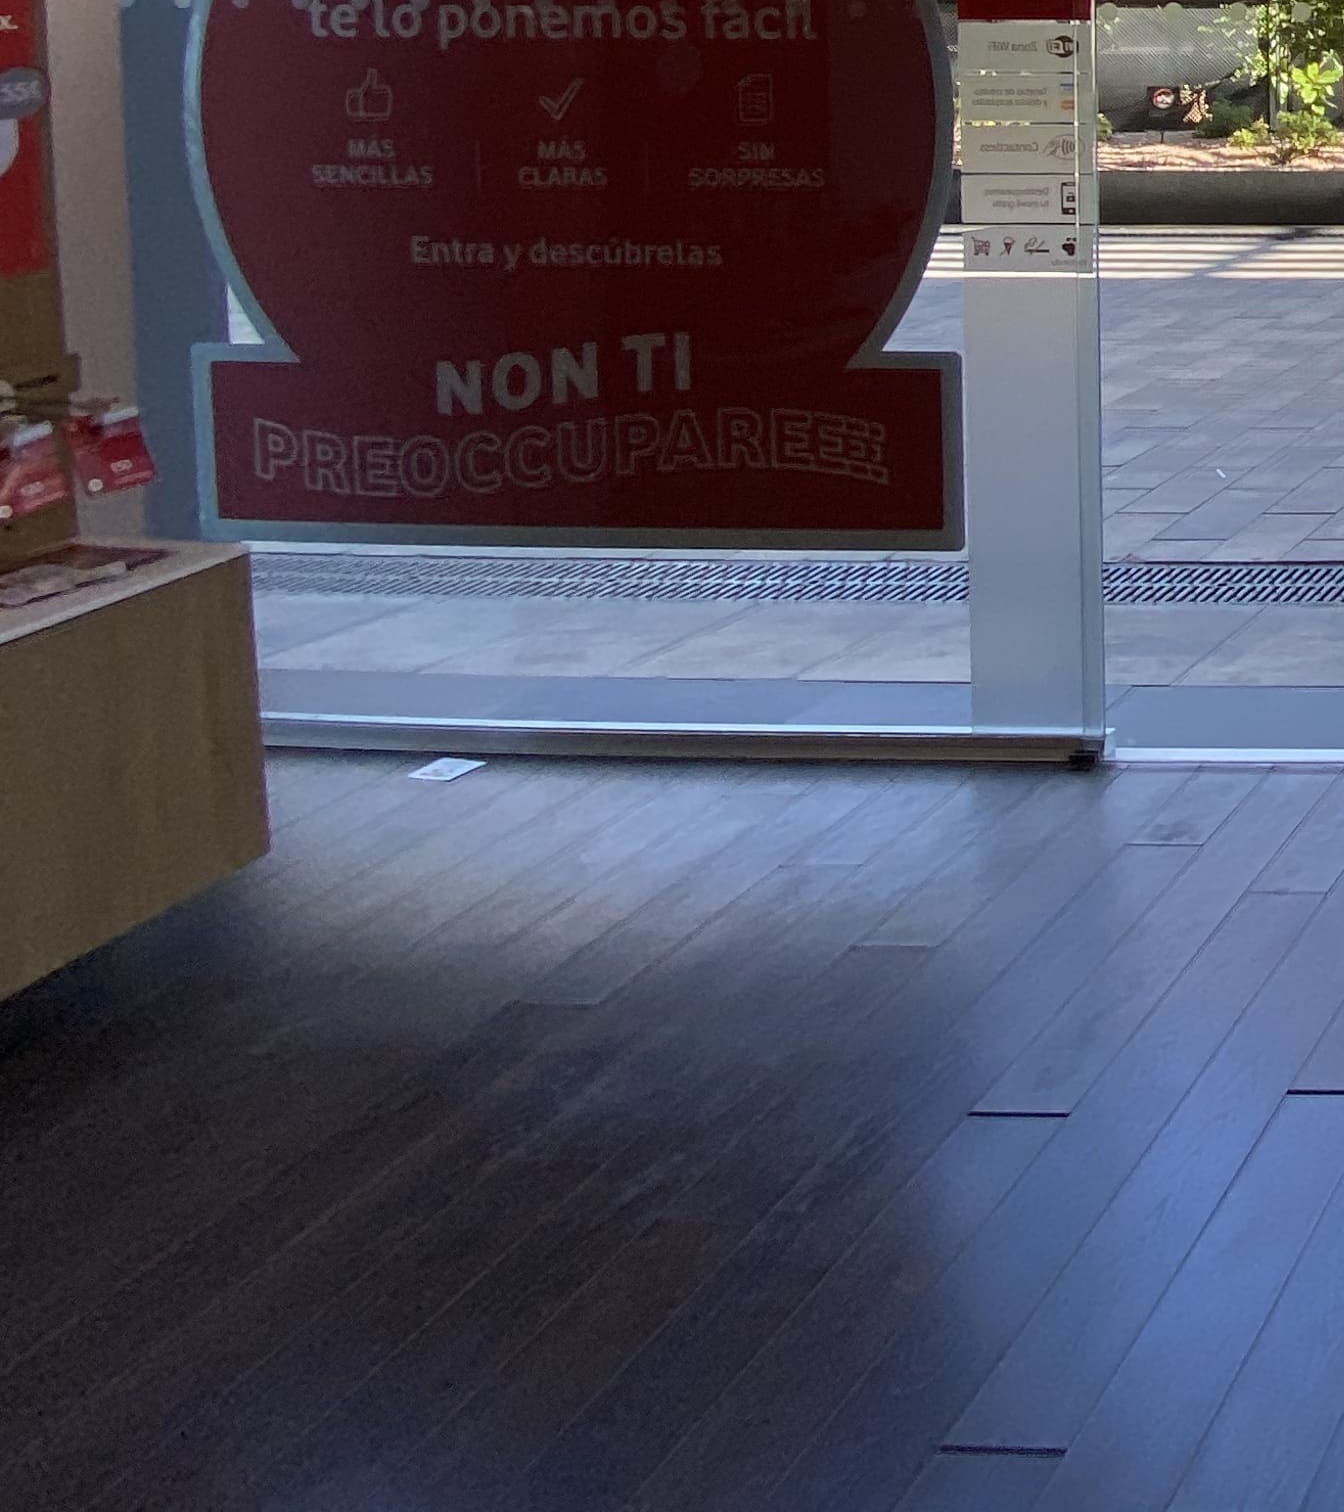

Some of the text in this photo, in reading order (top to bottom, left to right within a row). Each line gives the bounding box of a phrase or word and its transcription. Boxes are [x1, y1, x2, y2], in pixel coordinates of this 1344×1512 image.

[438, 0, 688, 51] ponemos
[736, 140, 777, 161] SIN
[311, 164, 433, 186] SENCILLAS
[517, 165, 609, 187] CLARAS
[688, 167, 825, 188] SORPRESAS
[409, 235, 496, 266] Entra
[502, 242, 522, 272] y
[435, 331, 693, 416] NON TI
